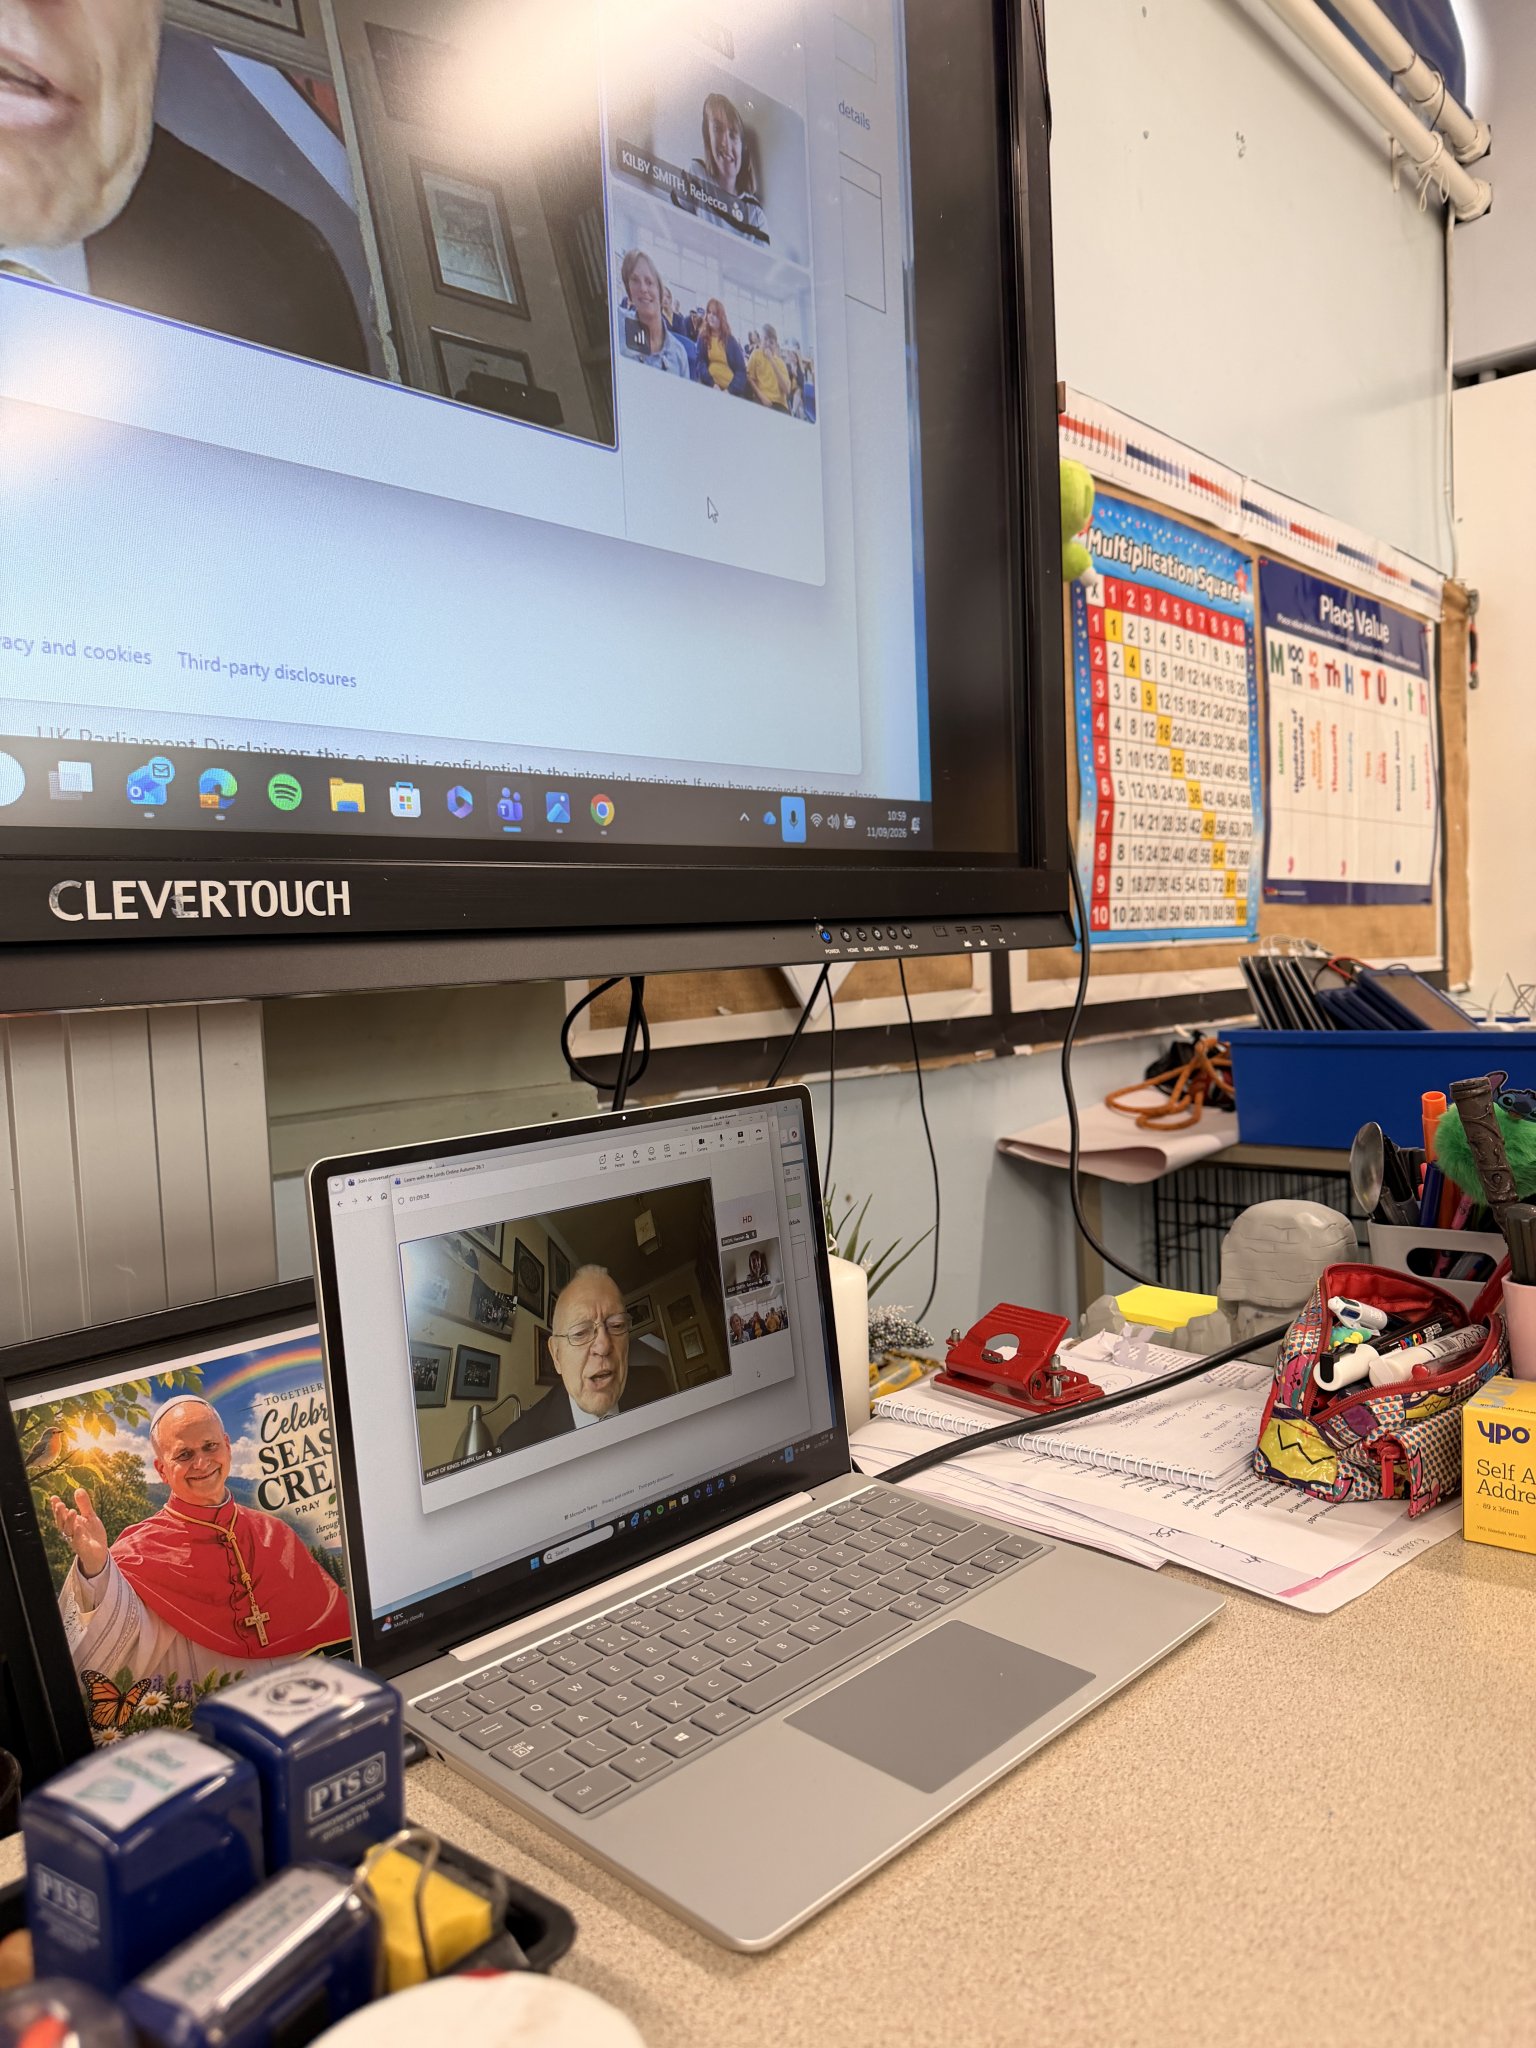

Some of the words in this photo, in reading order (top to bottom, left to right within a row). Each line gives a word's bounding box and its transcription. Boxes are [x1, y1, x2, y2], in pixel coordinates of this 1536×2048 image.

[838, 100, 871, 130] details
[622, 151, 650, 174] KILBY
[652, 165, 688, 196] SMITH,
[690, 184, 728, 213] Rebecca
[1088, 528, 1195, 586] Multiplication
[1198, 566, 1242, 604] Square
[1109, 586, 1116, 603] 1
[1127, 590, 1136, 608] 2
[1144, 594, 1152, 612] 3
[1160, 599, 1168, 616] 4
[1174, 604, 1181, 621] 5
[1186, 608, 1194, 625] 6
[1198, 613, 1205, 629] 7
[1222, 620, 1230, 637] 9
[1233, 624, 1245, 642] 10
[1320, 594, 1354, 631] Place
[1356, 609, 1390, 644] Value
[1092, 614, 1100, 633] 1
[1111, 619, 1117, 636] 1
[1127, 622, 1135, 640] 2
[1143, 628, 1151, 643] 3
[1160, 630, 1167, 646] 4
[1175, 633, 1182, 651] 5
[1188, 637, 1195, 654] 6
[1201, 642, 1207, 657] 7
[0, 636, 34, 657] acy
[42, 640, 76, 657] and
[84, 645, 152, 665] cookies
[1094, 646, 1103, 665] 2
[1270, 641, 1284, 676] M
[178, 651, 270, 681] Third-party
[274, 664, 358, 688] disclosures
[1325, 659, 1341, 689] Th
[1096, 679, 1104, 697] 3
[1345, 663, 1354, 695] H
[1360, 670, 1371, 700] T
[1096, 712, 1104, 731] 4
[1098, 745, 1106, 764] 5
[356, 753, 410, 765] email
[636, 773, 687, 787] recipient
[1101, 778, 1110, 796] 6
[888, 810, 907, 822] 10:59
[1101, 811, 1109, 829] 7
[867, 826, 908, 838] 11/09/2026
[1099, 843, 1107, 861] 8
[1097, 875, 1105, 893] 9
[49, 880, 351, 921] CLEVERTOUCH
[1093, 906, 1108, 924] 10
[409, 1193, 430, 1202] 01:09:38
[742, 1215, 753, 1224] HD
[264, 1383, 324, 1406] TOGETHER
[260, 1397, 329, 1443] Celebr
[258, 1428, 332, 1475] SEAS
[426, 1470, 439, 1478] HUNT
[447, 1462, 460, 1471] KINGS
[476, 1453, 486, 1461] Lord
[1476, 1459, 1515, 1481] Self
[1520, 1467, 1536, 1485] A
[258, 1461, 337, 1511] CRE
[1476, 1479, 1536, 1505] Addre
[295, 1500, 320, 1515] PRAY
[1483, 1502, 1491, 1511] 89
[324, 1531, 337, 1541] who
[555, 1547, 569, 1557] Search
[394, 1619, 408, 1628] Mostly
[409, 1611, 424, 1622] cloudy
[838, 1607, 852, 1616] M
[758, 1619, 770, 1627] H
[807, 1624, 821, 1632] N
[725, 1636, 737, 1644] G
[777, 1642, 788, 1650] B
[646, 1646, 657, 1654] R
[741, 1660, 753, 1668] V
[654, 1674, 665, 1682] D
[707, 1680, 719, 1688] C
[568, 1683, 582, 1692] W
[530, 1703, 543, 1712] Q
[669, 1700, 683, 1708] X
[715, 1711, 726, 1719] Alt
[631, 1720, 644, 1729] Z
[507, 1740, 527, 1751] Caps
[313, 1770, 361, 1812] PTS
[577, 1785, 592, 1796] Ctrl
